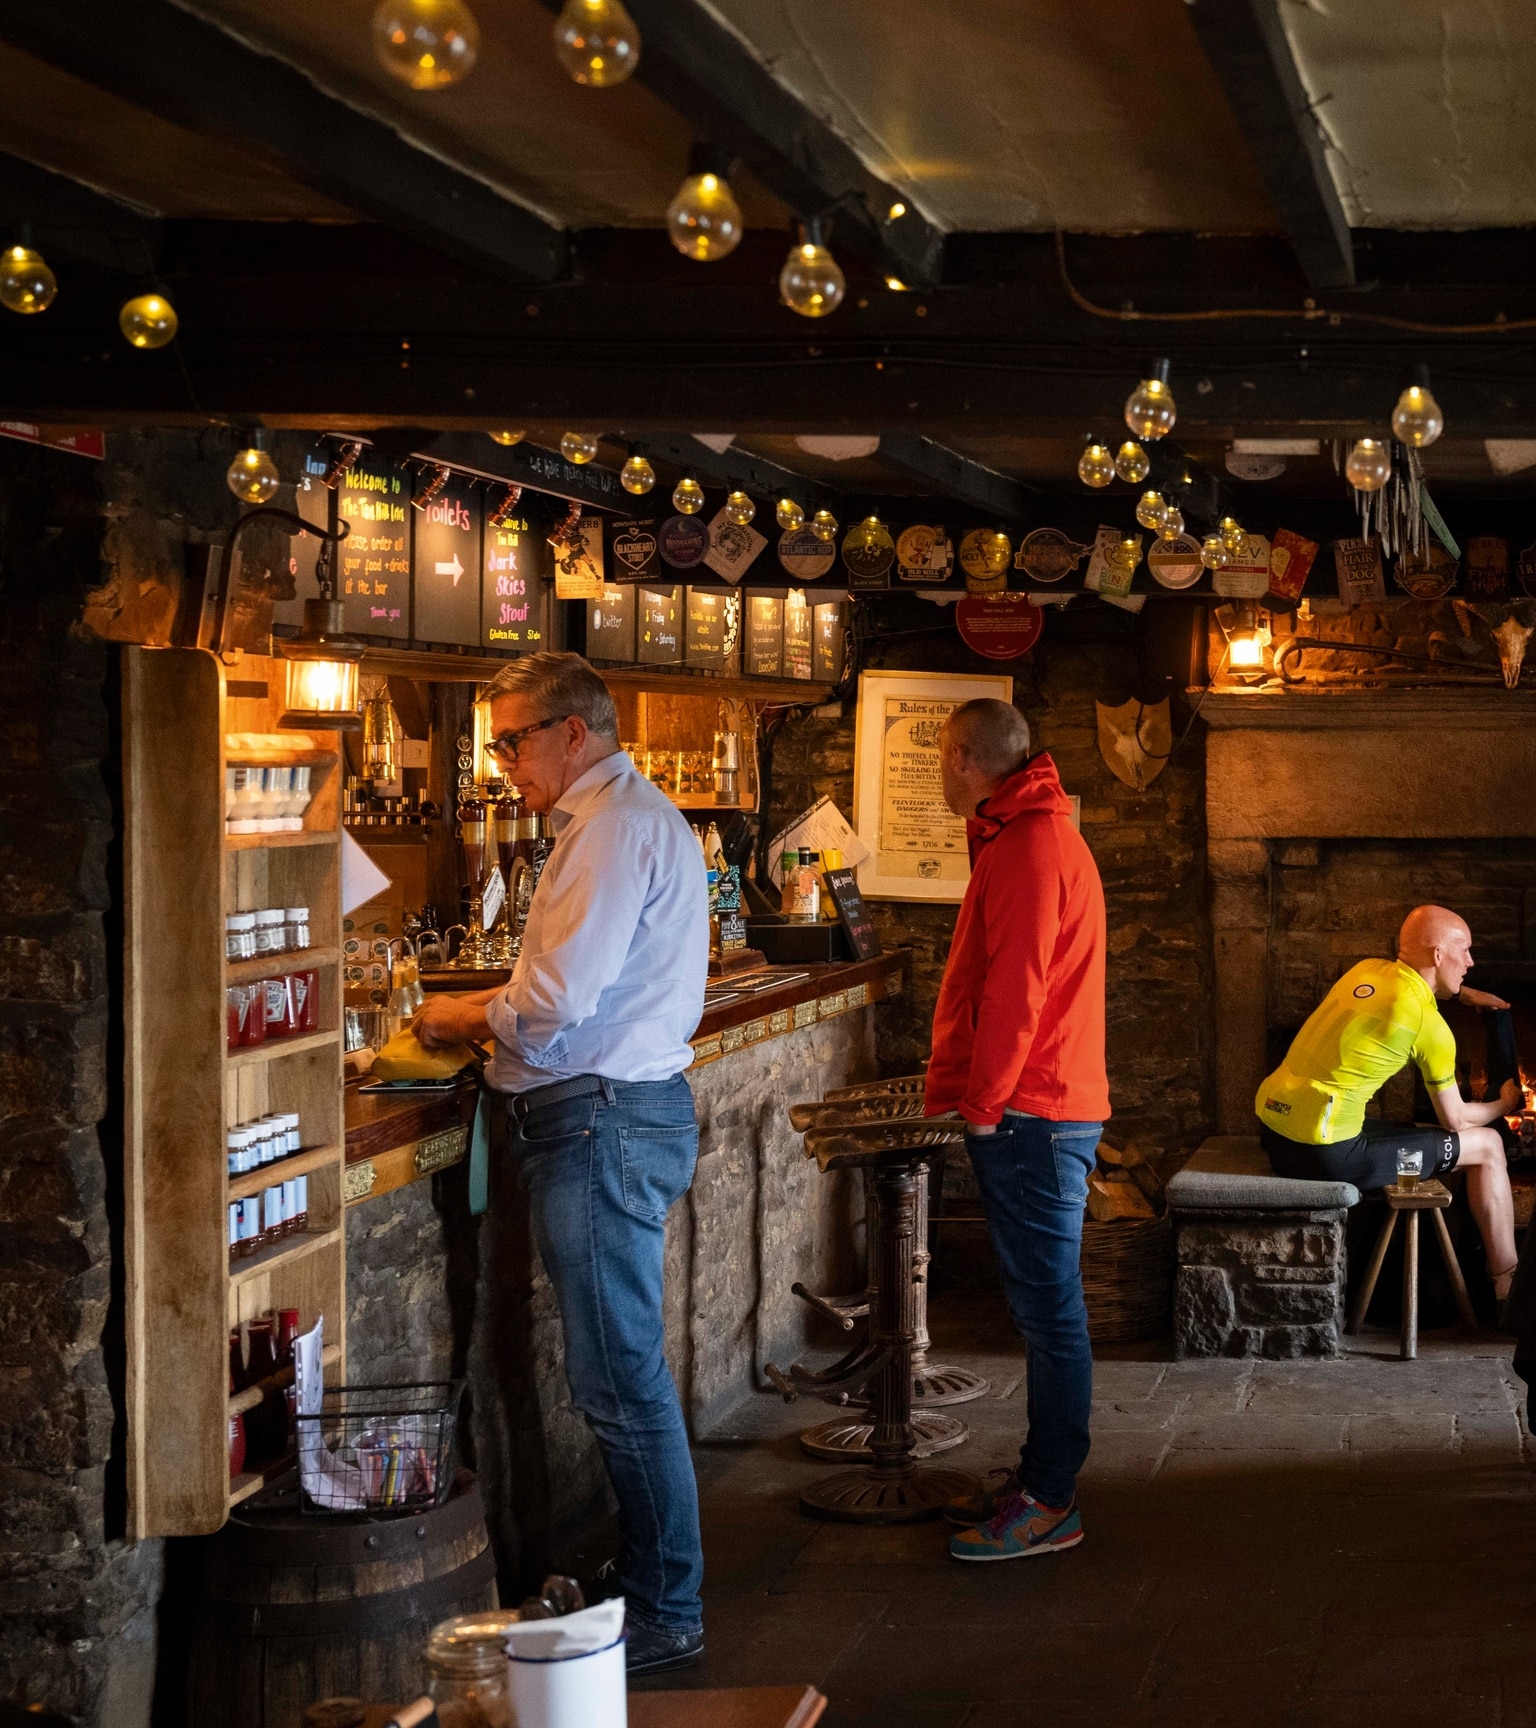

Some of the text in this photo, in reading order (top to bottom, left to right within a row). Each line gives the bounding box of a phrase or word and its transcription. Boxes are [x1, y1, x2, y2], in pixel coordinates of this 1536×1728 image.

[345, 467, 401, 494] Welcome to
[342, 496, 359, 517] The
[390, 503, 405, 522] Inn
[593, 521, 599, 529] 8
[371, 535, 393, 551] order
[394, 537, 404, 551] all
[781, 545, 832, 555] ATLANTIC HOP
[488, 550, 518, 572] Dark
[962, 552, 979, 562] HOLY
[1343, 553, 1373, 564] HAIR
[344, 557, 362, 576] your
[365, 558, 382, 576] food
[1347, 568, 1374, 580] DOG
[357, 579, 371, 595] the
[375, 579, 388, 595] bar
[496, 575, 526, 596] Skies
[499, 603, 530, 624] Stout
[899, 702, 927, 713] Rules
[929, 706, 935, 715] of
[937, 704, 950, 714] the
[794, 899, 813, 909] 732
[1443, 1136, 1453, 1161] COL
